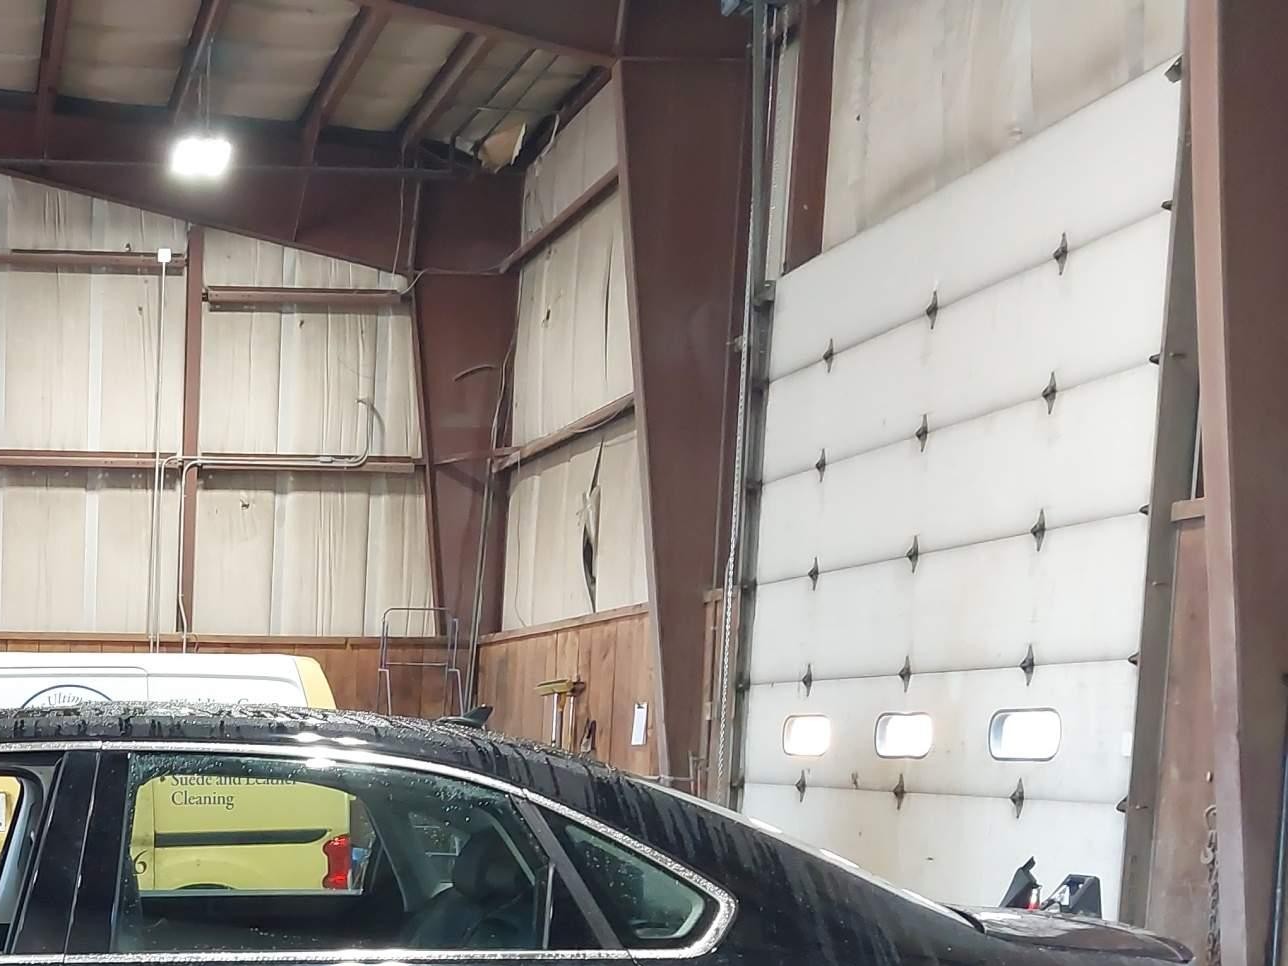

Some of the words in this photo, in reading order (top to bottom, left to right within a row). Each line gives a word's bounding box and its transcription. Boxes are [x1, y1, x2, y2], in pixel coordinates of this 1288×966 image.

[47, 692, 82, 706] Ultim
[171, 775, 213, 786] Suede
[215, 776, 241, 786] and
[171, 789, 235, 810] Cleaning
